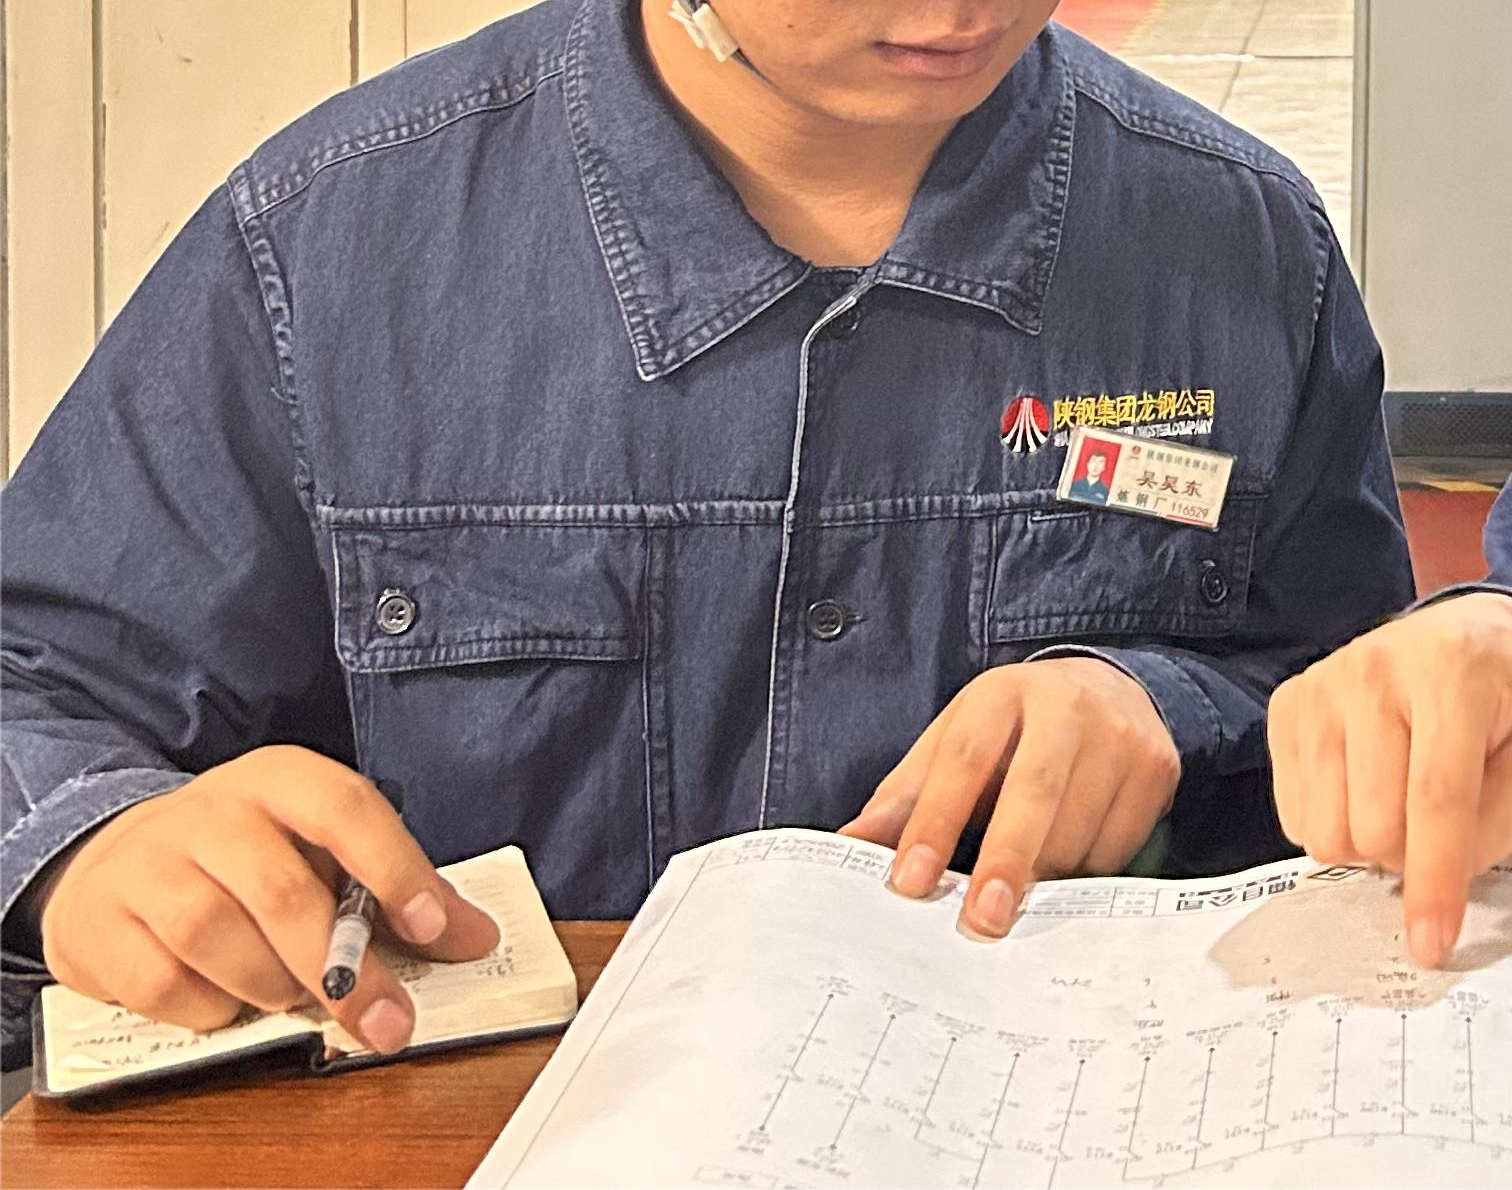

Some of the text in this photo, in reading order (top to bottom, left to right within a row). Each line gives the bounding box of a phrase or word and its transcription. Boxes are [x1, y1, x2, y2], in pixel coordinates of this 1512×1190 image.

[1053, 389, 1216, 431] 陕钢集团龙钢公司
[1170, 500, 1210, 519] 116529
